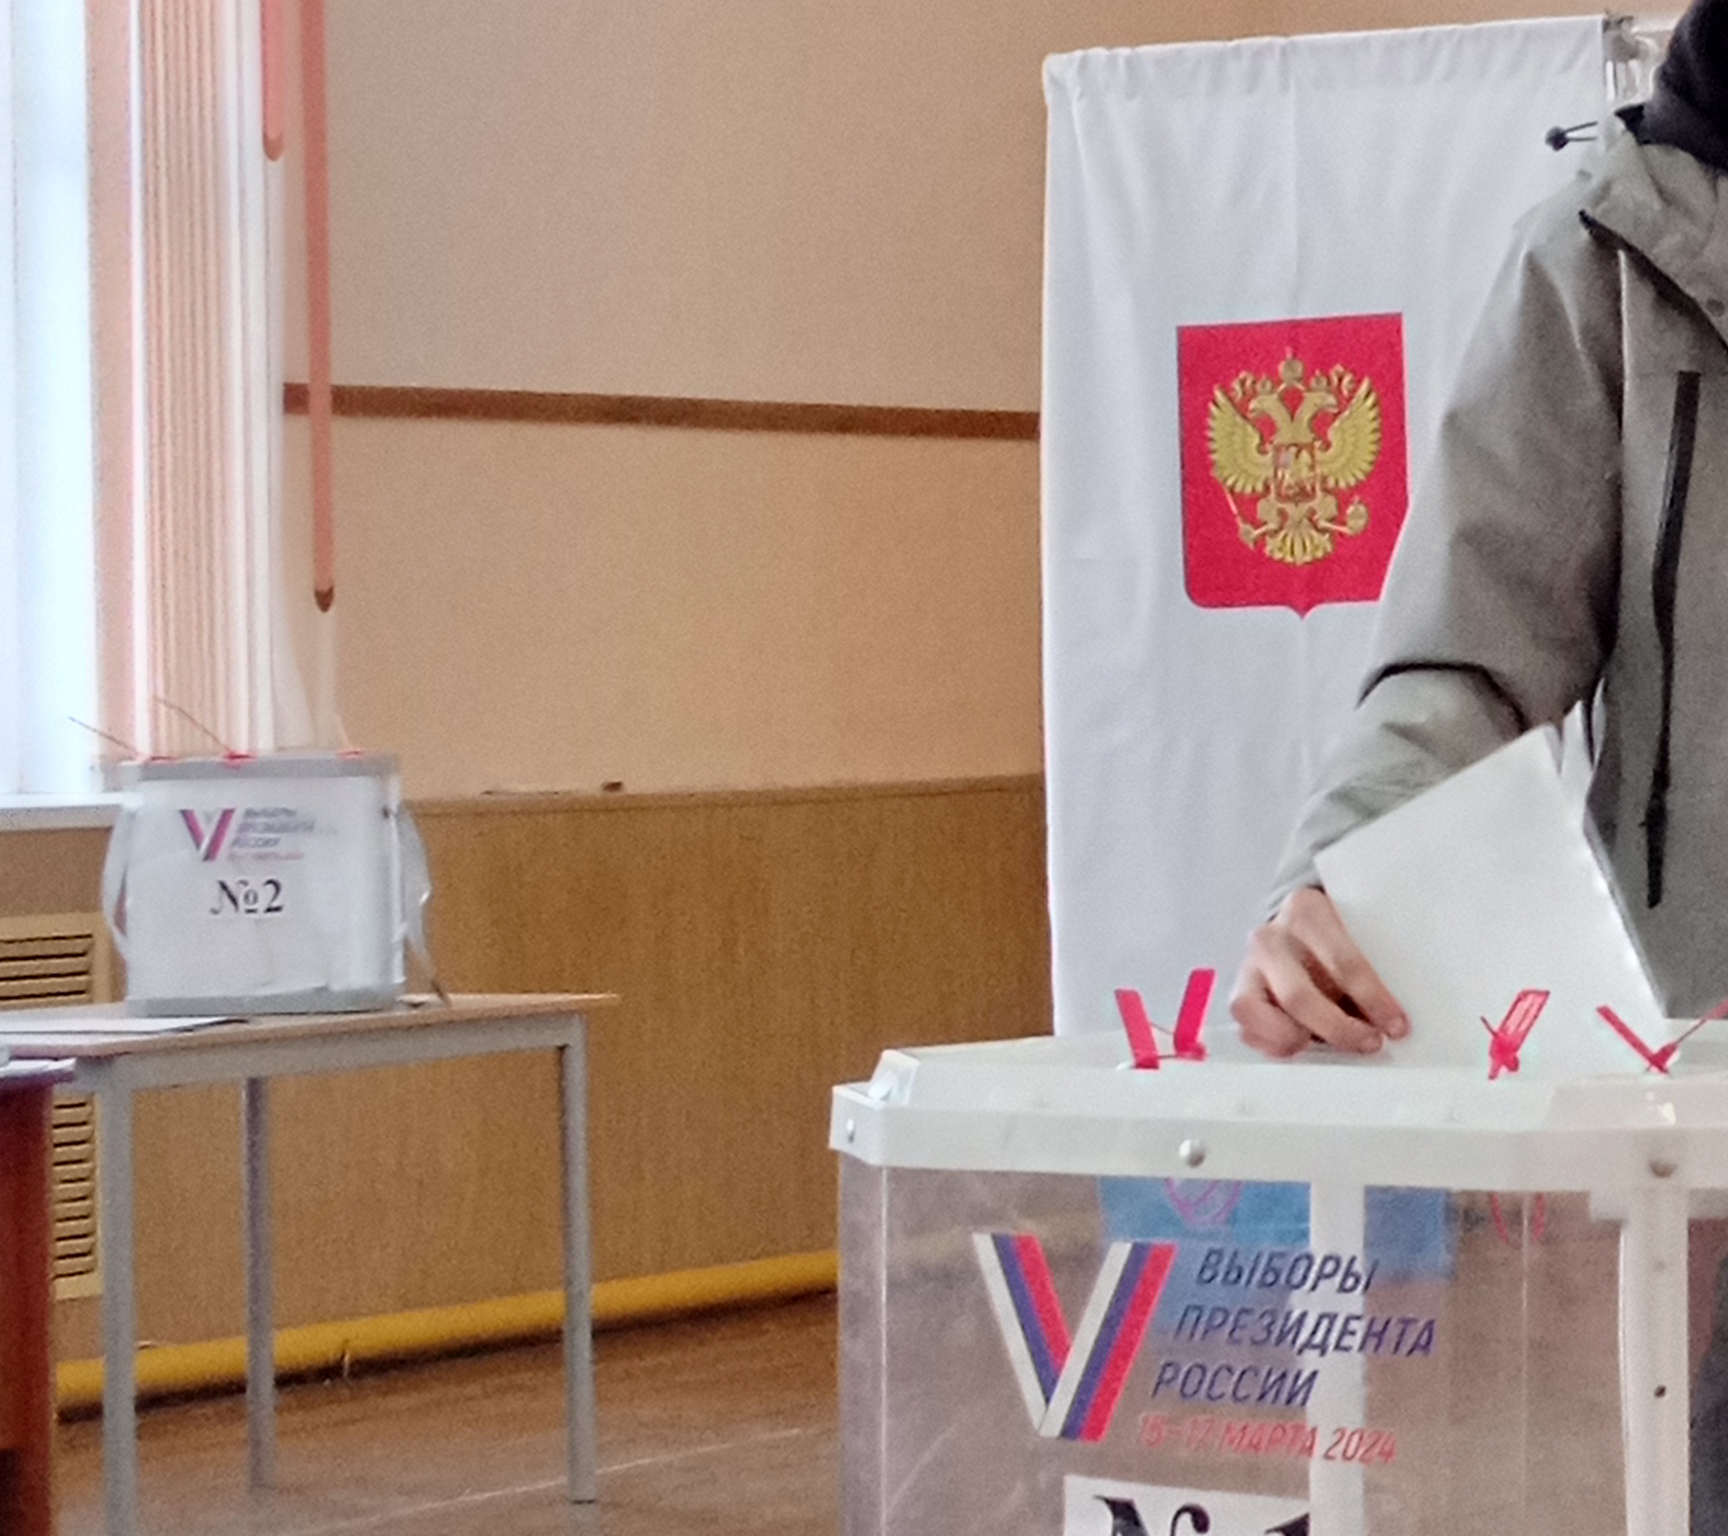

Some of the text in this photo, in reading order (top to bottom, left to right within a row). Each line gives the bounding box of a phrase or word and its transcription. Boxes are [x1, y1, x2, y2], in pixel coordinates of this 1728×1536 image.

[1196, 1248, 1380, 1294] ВЫБОРЫ
[1173, 1304, 1436, 1357] ПРЕЗИДЕНТА
[1151, 1361, 1319, 1407] РОССИИ
[1223, 1420, 1318, 1458] МАРТА
[1323, 1426, 1398, 1464] 2024
